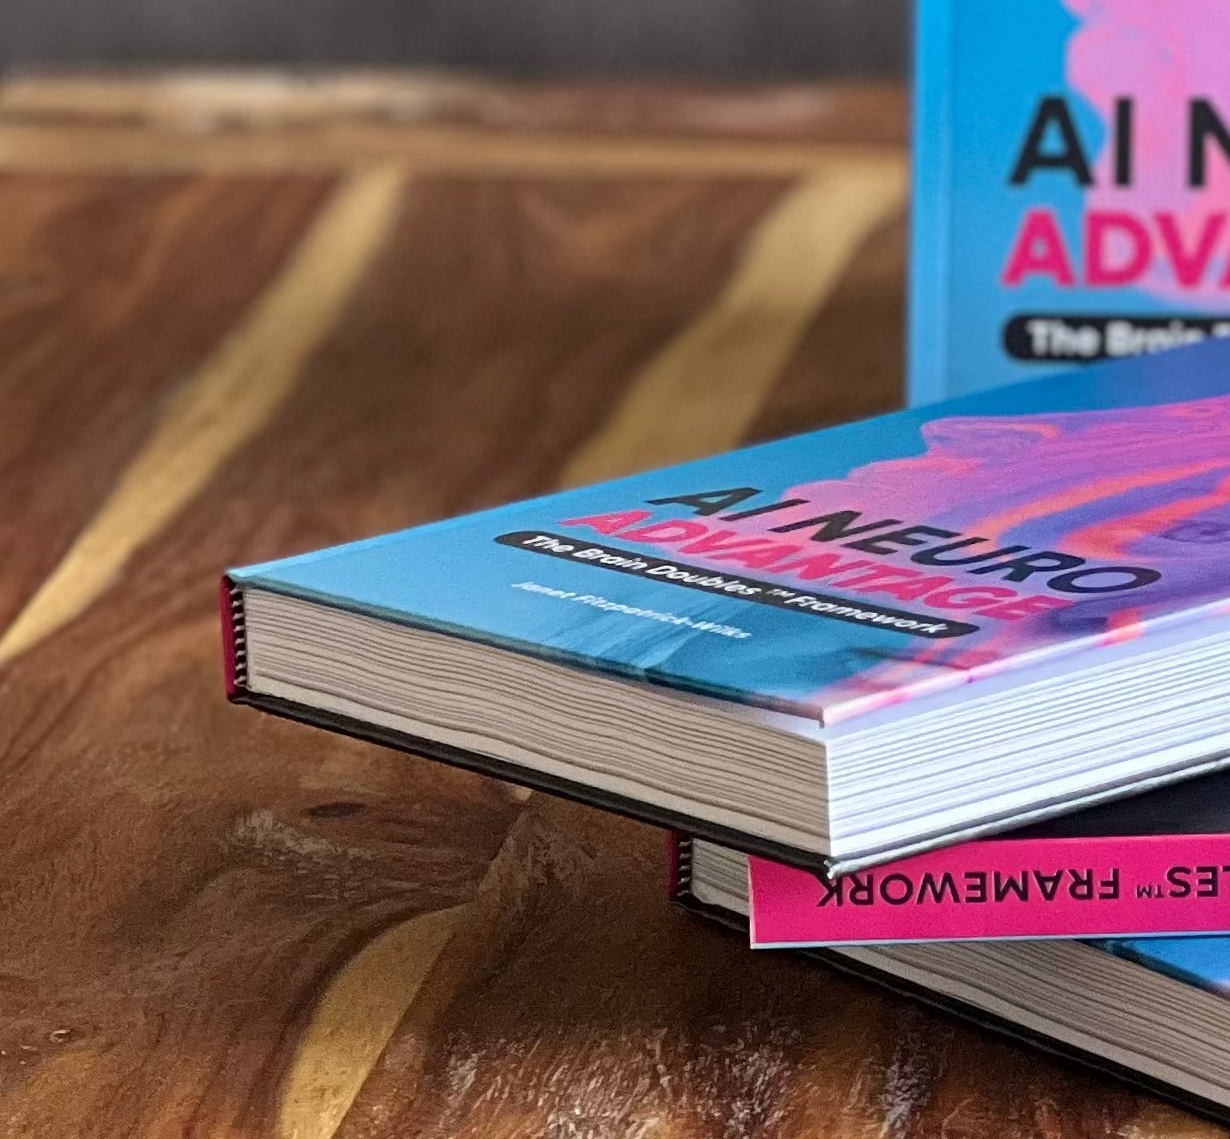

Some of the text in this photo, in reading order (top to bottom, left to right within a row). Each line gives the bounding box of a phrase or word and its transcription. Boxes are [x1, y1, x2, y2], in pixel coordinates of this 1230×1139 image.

[1009, 96, 1134, 188] AI
[1026, 319, 1099, 357] The
[523, 535, 574, 553] The
[572, 548, 649, 571] Brain
[784, 595, 949, 634] Framework
[558, 510, 1086, 621] ADVANTAGE
[646, 486, 1163, 594] AI NEURO
[816, 867, 1121, 908] FRAMEWORK
